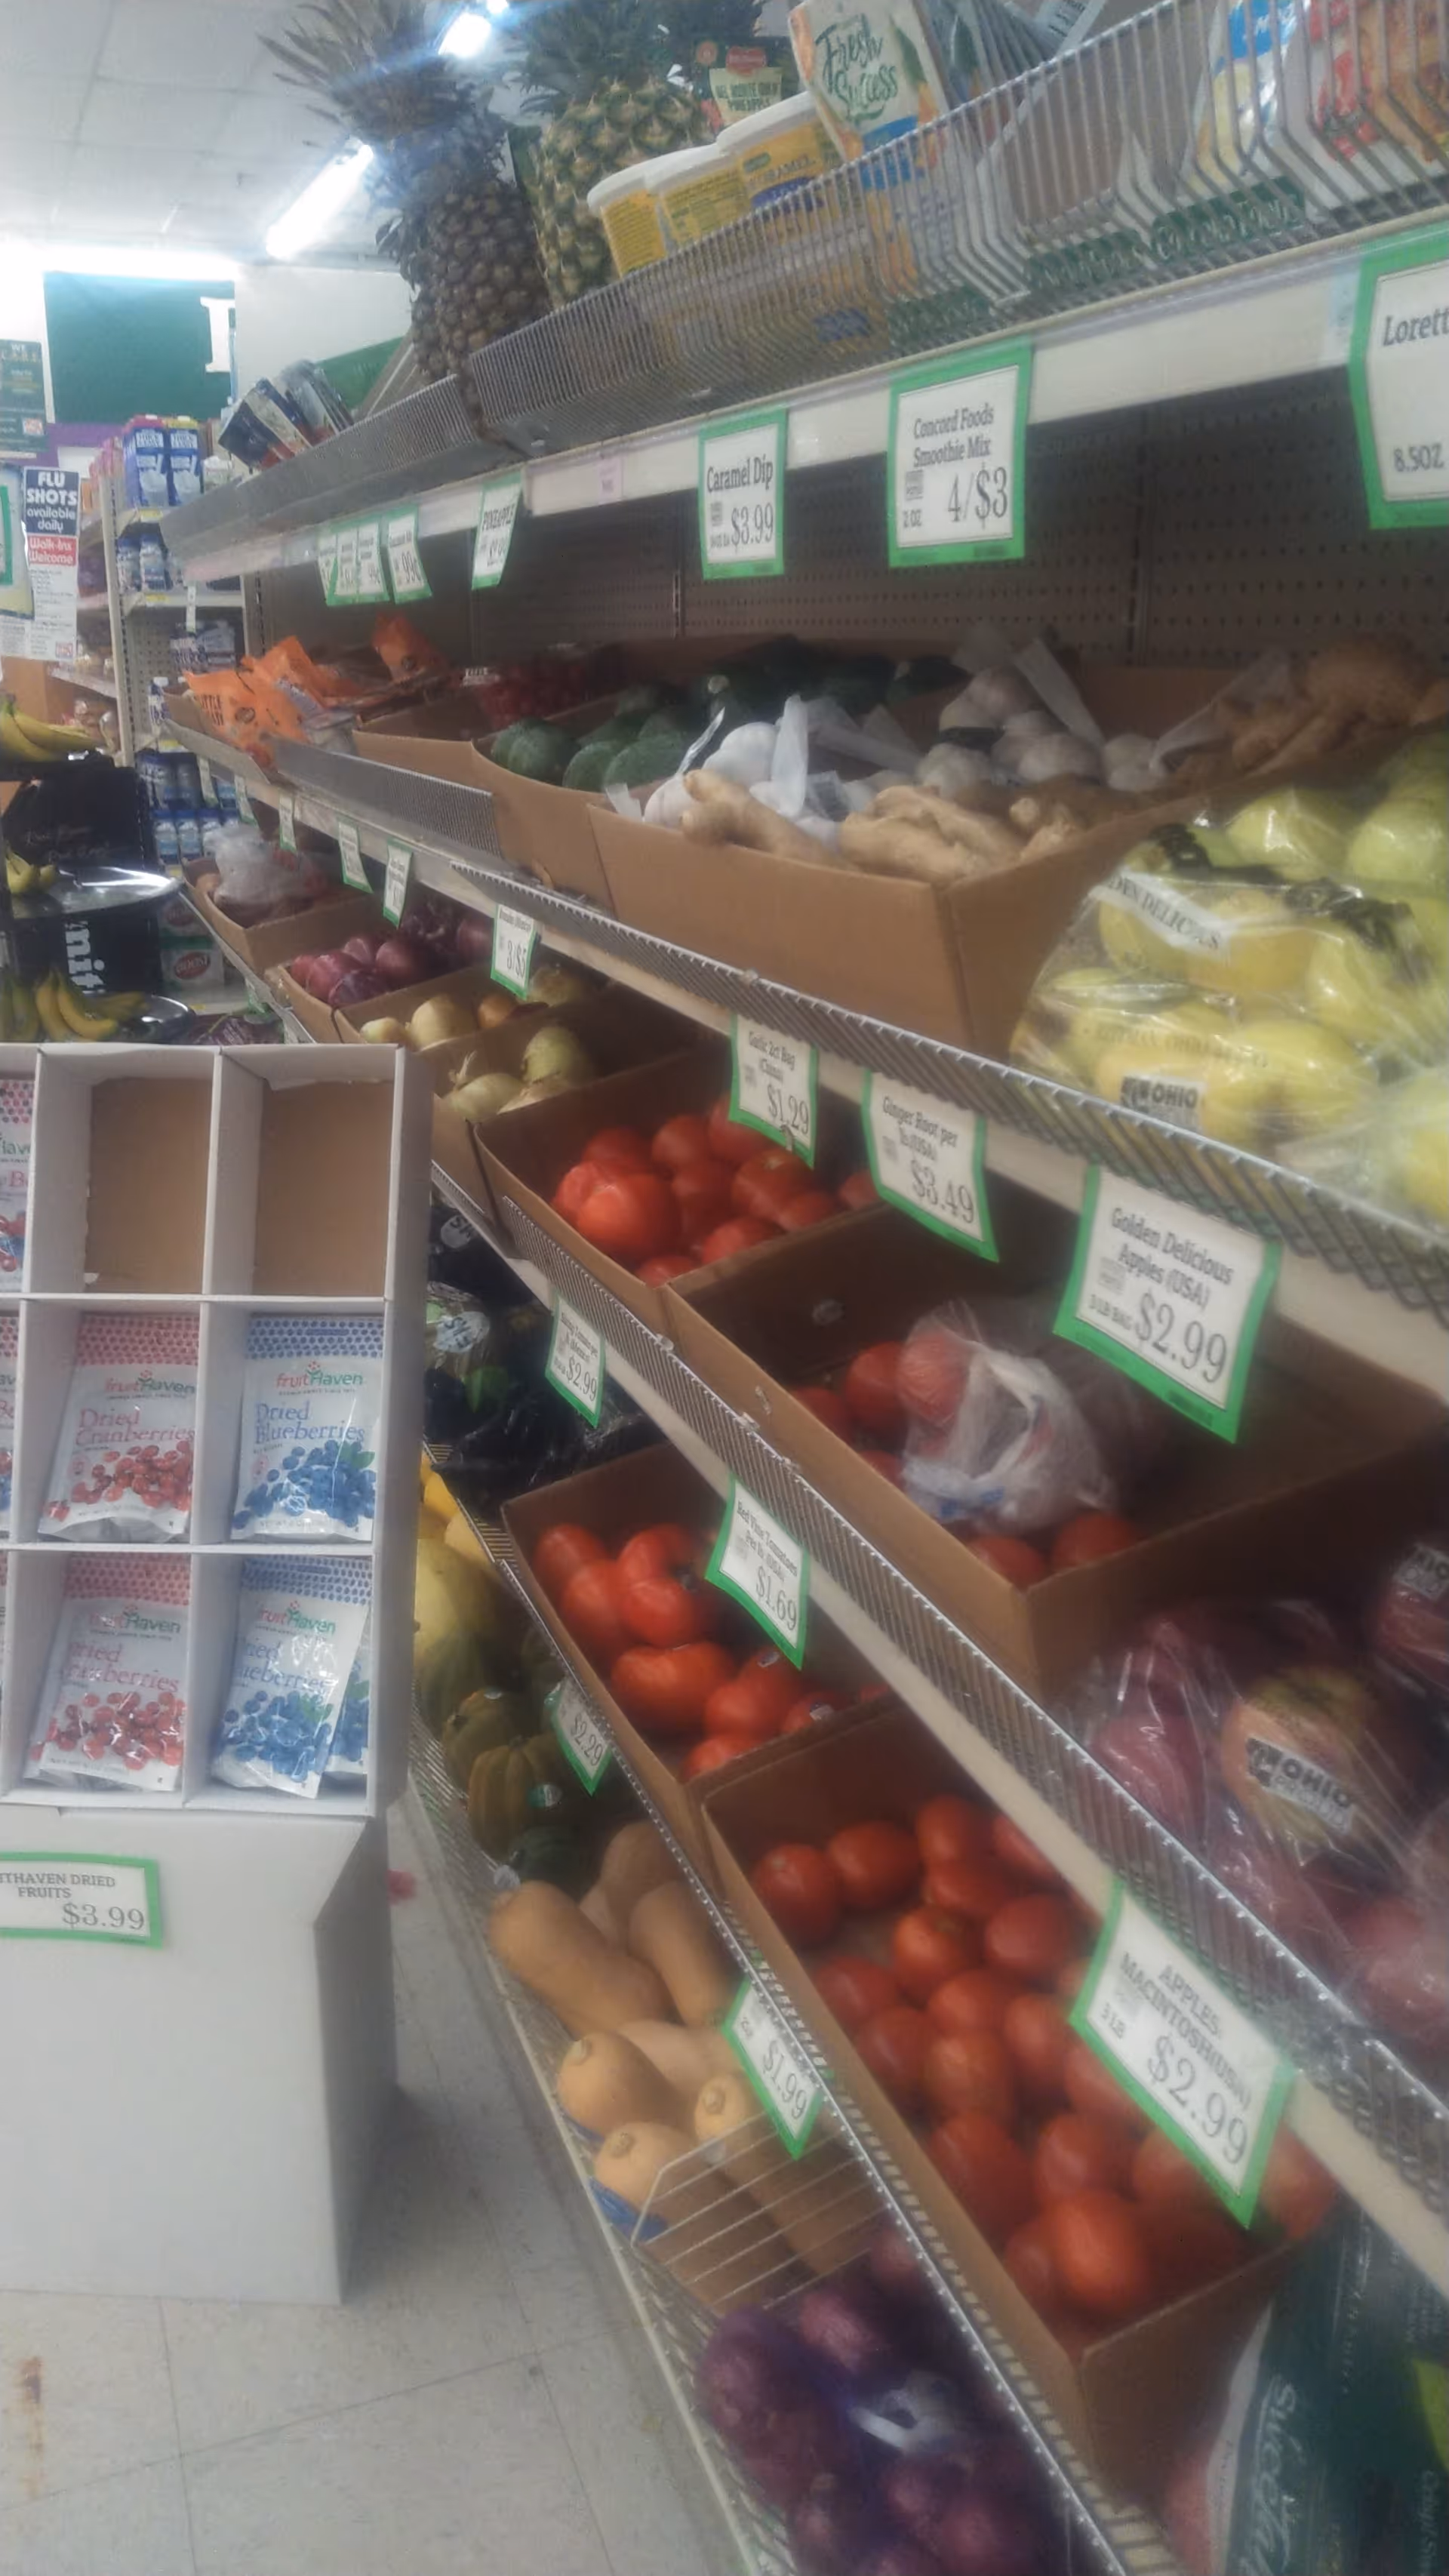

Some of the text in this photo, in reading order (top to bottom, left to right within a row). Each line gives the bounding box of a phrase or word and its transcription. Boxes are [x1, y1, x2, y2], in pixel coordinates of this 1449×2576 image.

[814, 14, 883, 94] Fresh
[835, 65, 898, 115] Success
[914, 402, 994, 439] Concord Foods
[914, 435, 991, 468] Smoothie Mix
[38, 471, 65, 488] FLU
[707, 454, 774, 492] Caramel Dip
[26, 489, 77, 505] SHOTS
[26, 506, 75, 520] available
[948, 461, 1008, 529] 4/$3
[38, 518, 63, 533] daily
[731, 502, 774, 554] $3.99
[29, 549, 73, 565] Welcome
[767, 1084, 809, 1134] $1.29
[1152, 1082, 1198, 1109] OHIO
[883, 1096, 958, 1148] Ginger Root per
[910, 1155, 974, 1223] $3.49
[1112, 1207, 1235, 1285] Golden Delicious
[1118, 1243, 1211, 1313] Apples (USA)
[1134, 1286, 1227, 1384] $2.99
[275, 1369, 364, 1389] fruitHaven
[566, 1355, 597, 1402] $2.99
[78, 1405, 141, 1427] Dried
[255, 1399, 311, 1423] Dried
[75, 1423, 195, 1446] Cranberries
[255, 1420, 366, 1445] Blueberries
[764, 1530, 798, 1577] Tomatoes
[755, 1564, 797, 1631] $1.69
[570, 1712, 604, 1767] $2.29
[1282, 1756, 1354, 1809] OHIO
[17, 1886, 72, 1899] FRUITS
[70, 1874, 115, 1888] DRIED
[62, 1901, 145, 1931] $3.99
[762, 2039, 807, 2120] $1.99
[1148, 2035, 1247, 2165] $2.99
